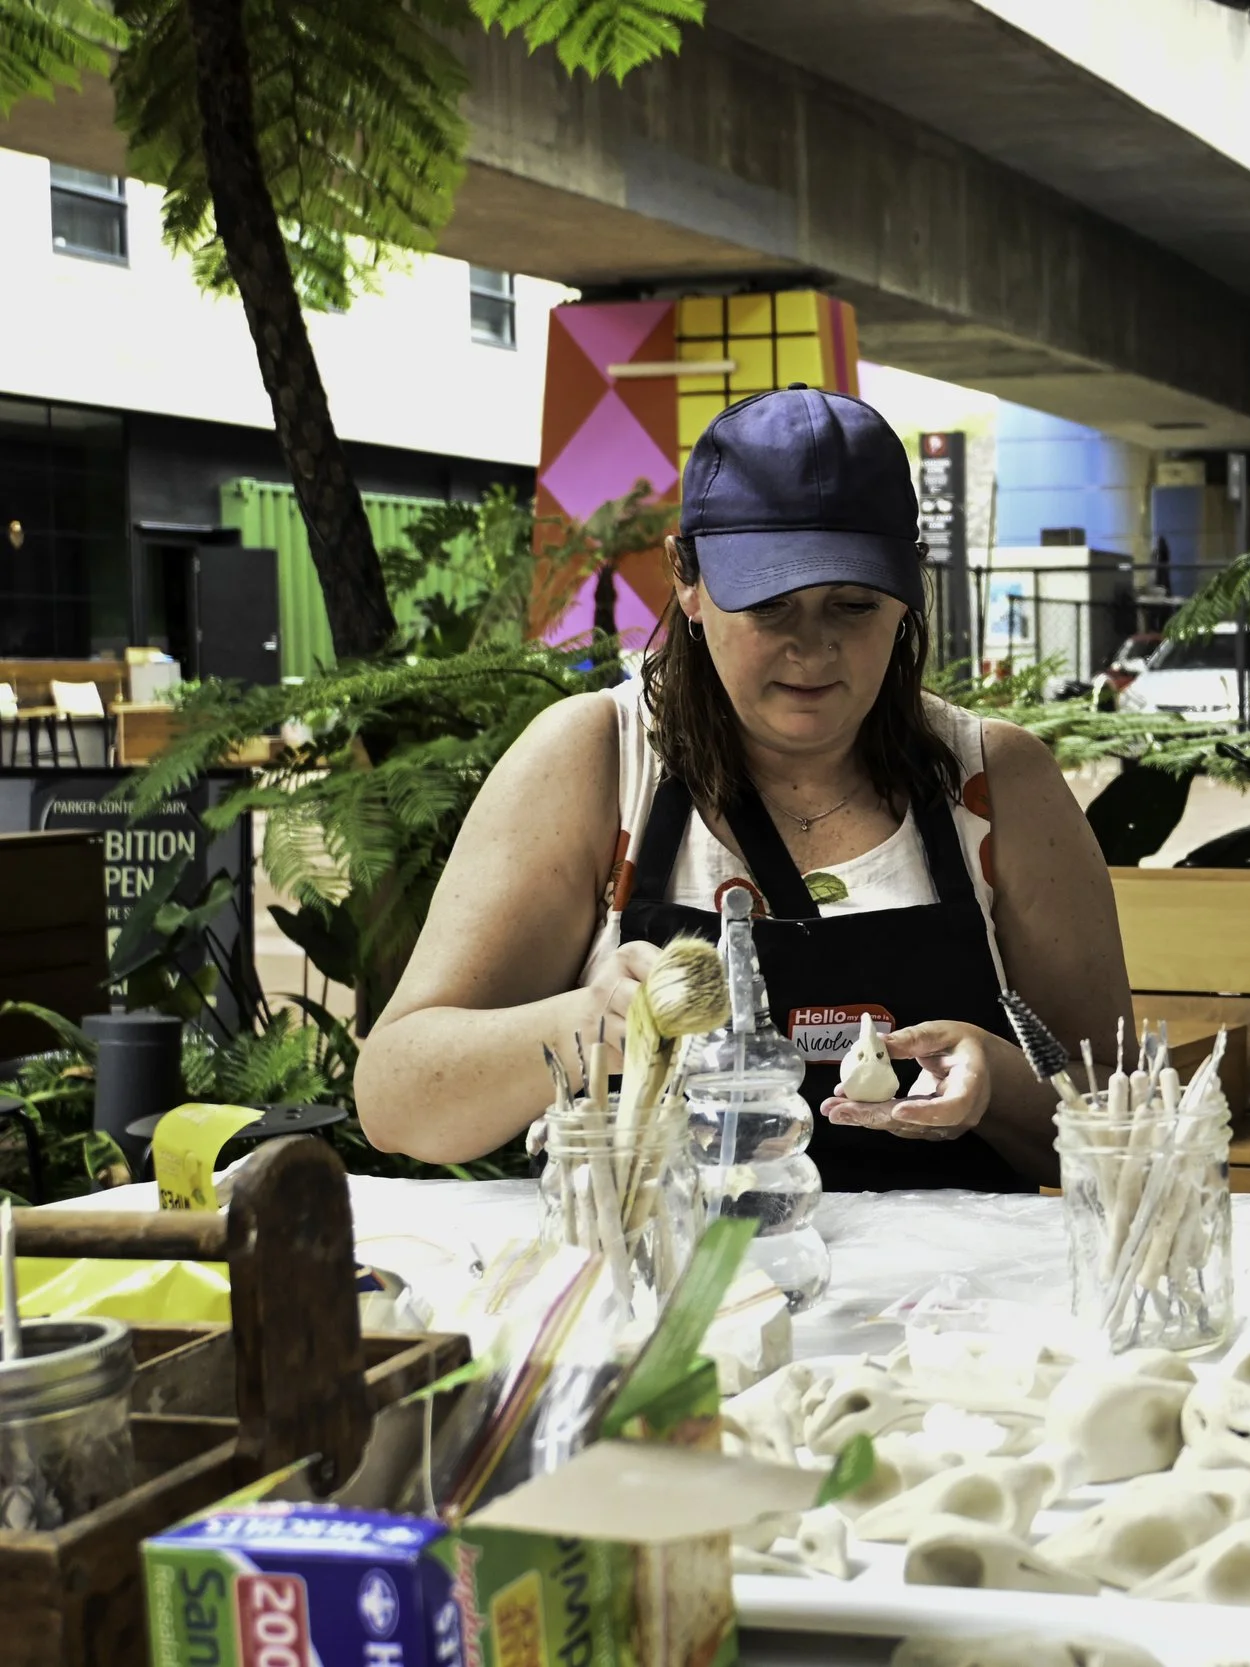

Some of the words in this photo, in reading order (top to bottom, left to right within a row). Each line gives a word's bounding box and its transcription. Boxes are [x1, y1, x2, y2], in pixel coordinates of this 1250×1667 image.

[53, 801, 96, 815] PARKER
[99, 801, 187, 815] CONTERARY
[104, 830, 196, 862] BITION
[104, 865, 155, 898] PEN
[795, 1009, 847, 1025] Hello
[179, 1565, 227, 1667] San
